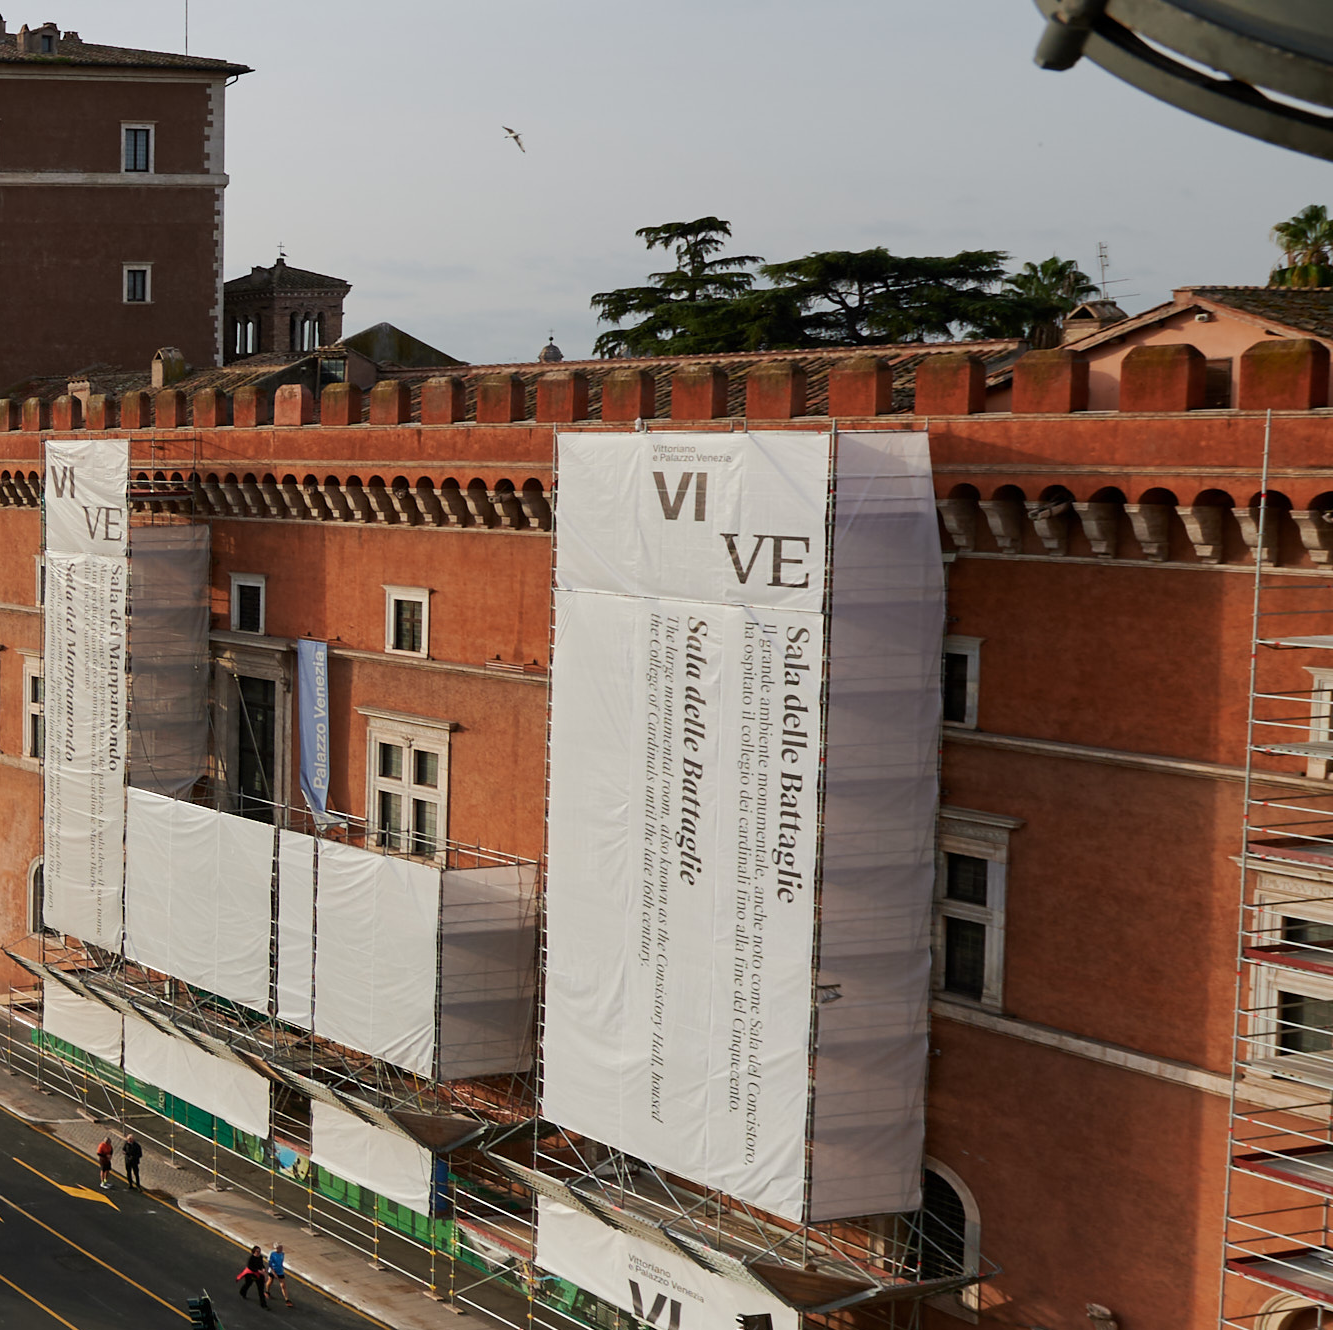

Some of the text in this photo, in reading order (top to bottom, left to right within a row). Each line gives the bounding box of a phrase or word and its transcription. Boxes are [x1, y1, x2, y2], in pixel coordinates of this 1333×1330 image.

[50, 466, 75, 499] VI
[652, 444, 696, 453] Vittoriano
[653, 471, 707, 522] VI
[660, 454, 694, 462] Palazzo
[697, 454, 732, 463] Venezia
[82, 506, 123, 542] VE
[720, 532, 810, 590] VE
[65, 563, 76, 762] Sala del Mappamondo
[108, 564, 123, 772] Sala del Mappamondo
[314, 651, 326, 790] Palazzo Venezia
[638, 613, 661, 966] the College of Cardinals until the late 16th century.
[674, 616, 709, 886] Sala delle Battaglie
[771, 626, 810, 904] Sala delle Battaglie
[650, 616, 680, 1124] The large monumental room, also known as the Consistory Hall, housed
[728, 622, 759, 1113] ha ospitato il collegio dei cardinali fino alla fine del Cinquecento.
[744, 624, 777, 1166] Il grande ambiente monumentale, anche noto come Sala del Concistoro,
[628, 1254, 671, 1278] Vittoriano
[635, 1266, 669, 1287] Palazzo
[672, 1282, 705, 1303] Venezia
